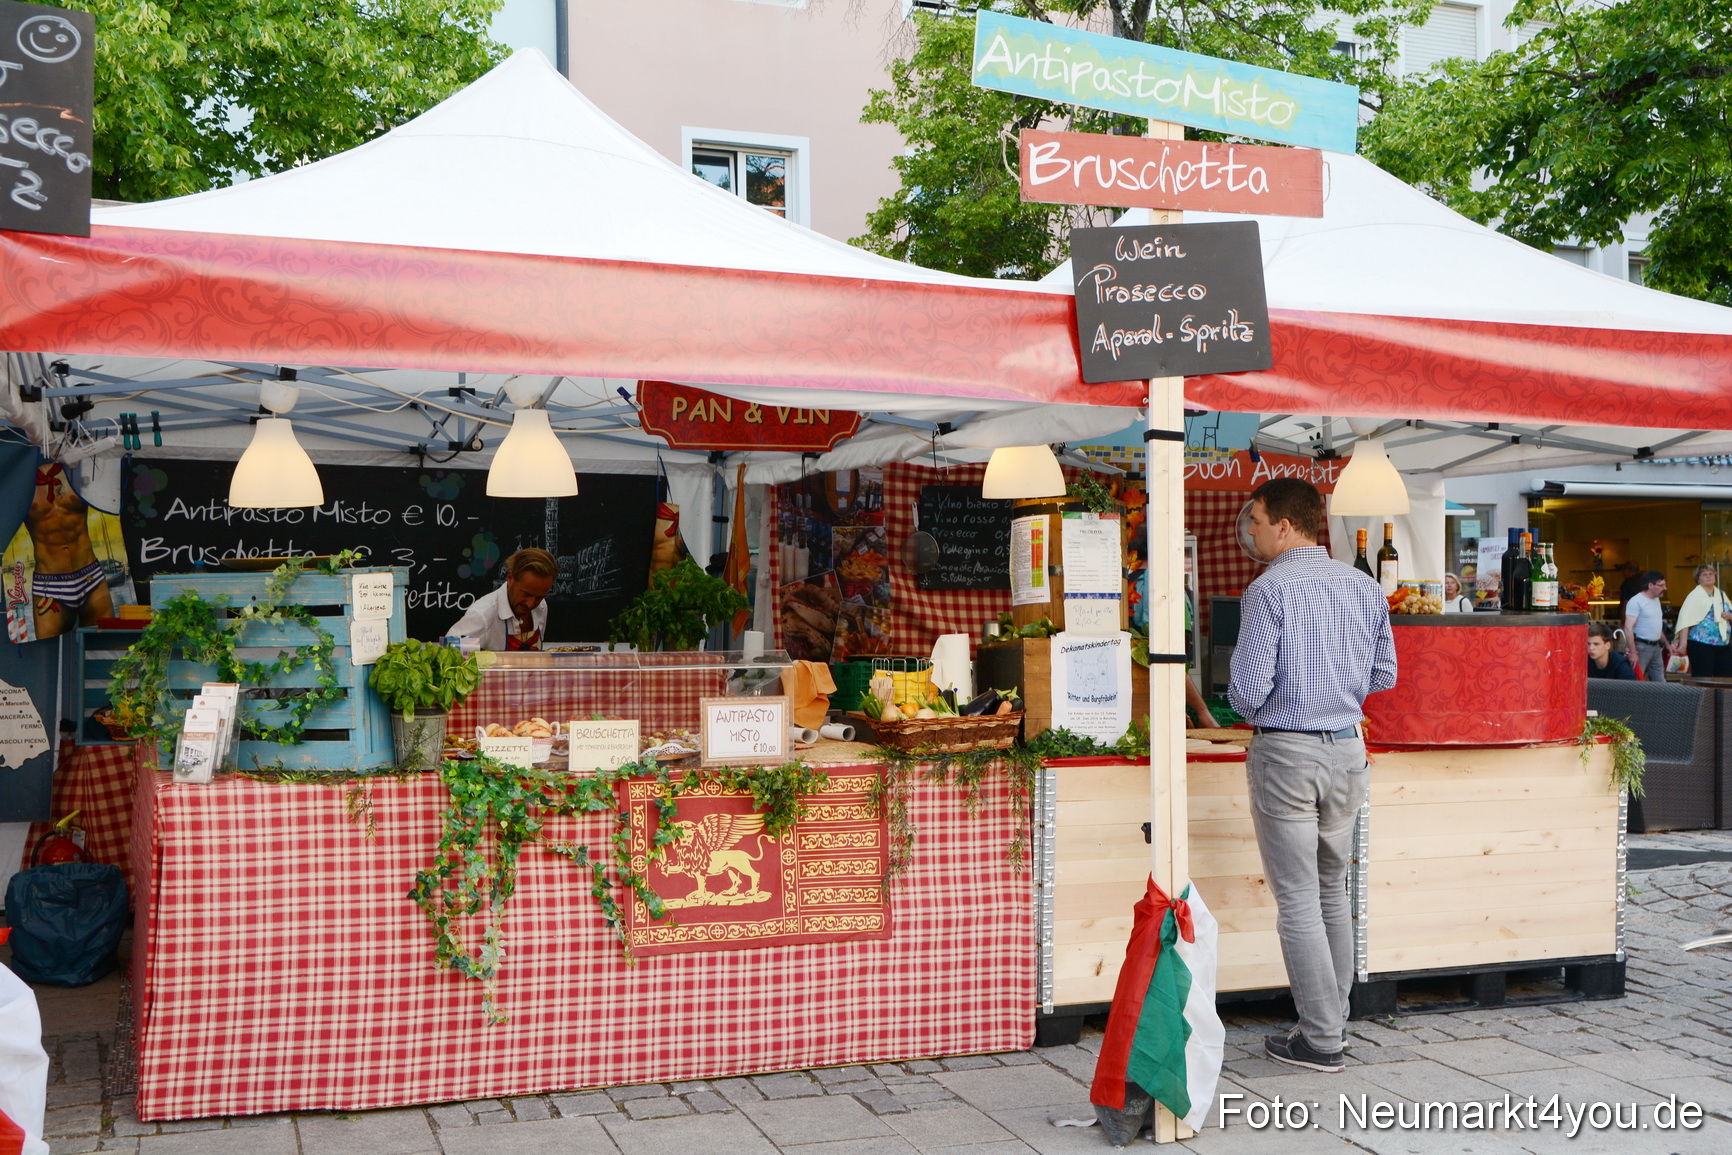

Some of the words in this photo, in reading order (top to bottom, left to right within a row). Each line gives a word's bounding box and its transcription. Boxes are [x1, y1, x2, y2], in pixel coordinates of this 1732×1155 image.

[1028, 141, 1269, 195] Bruschetta
[1115, 235, 1187, 262] Wein
[1077, 264, 1207, 304] Prosecco
[672, 397, 732, 423] PAN
[745, 402, 763, 424] &
[776, 406, 830, 425] VIN
[967, 496, 999, 509] bianco
[164, 497, 305, 527] Antipasto
[313, 500, 391, 525] Misto
[401, 504, 424, 526] €
[934, 511, 958, 524] Vino
[963, 514, 996, 525] rosso
[932, 527, 979, 540] Prosecco
[1060, 638, 1122, 655] Dekanatskindertag
[1082, 695, 1090, 703] und
[716, 708, 775, 723] ANTIPASTO
[576, 727, 635, 739] BRUSCHETTA
[729, 728, 761, 742] MISTO
